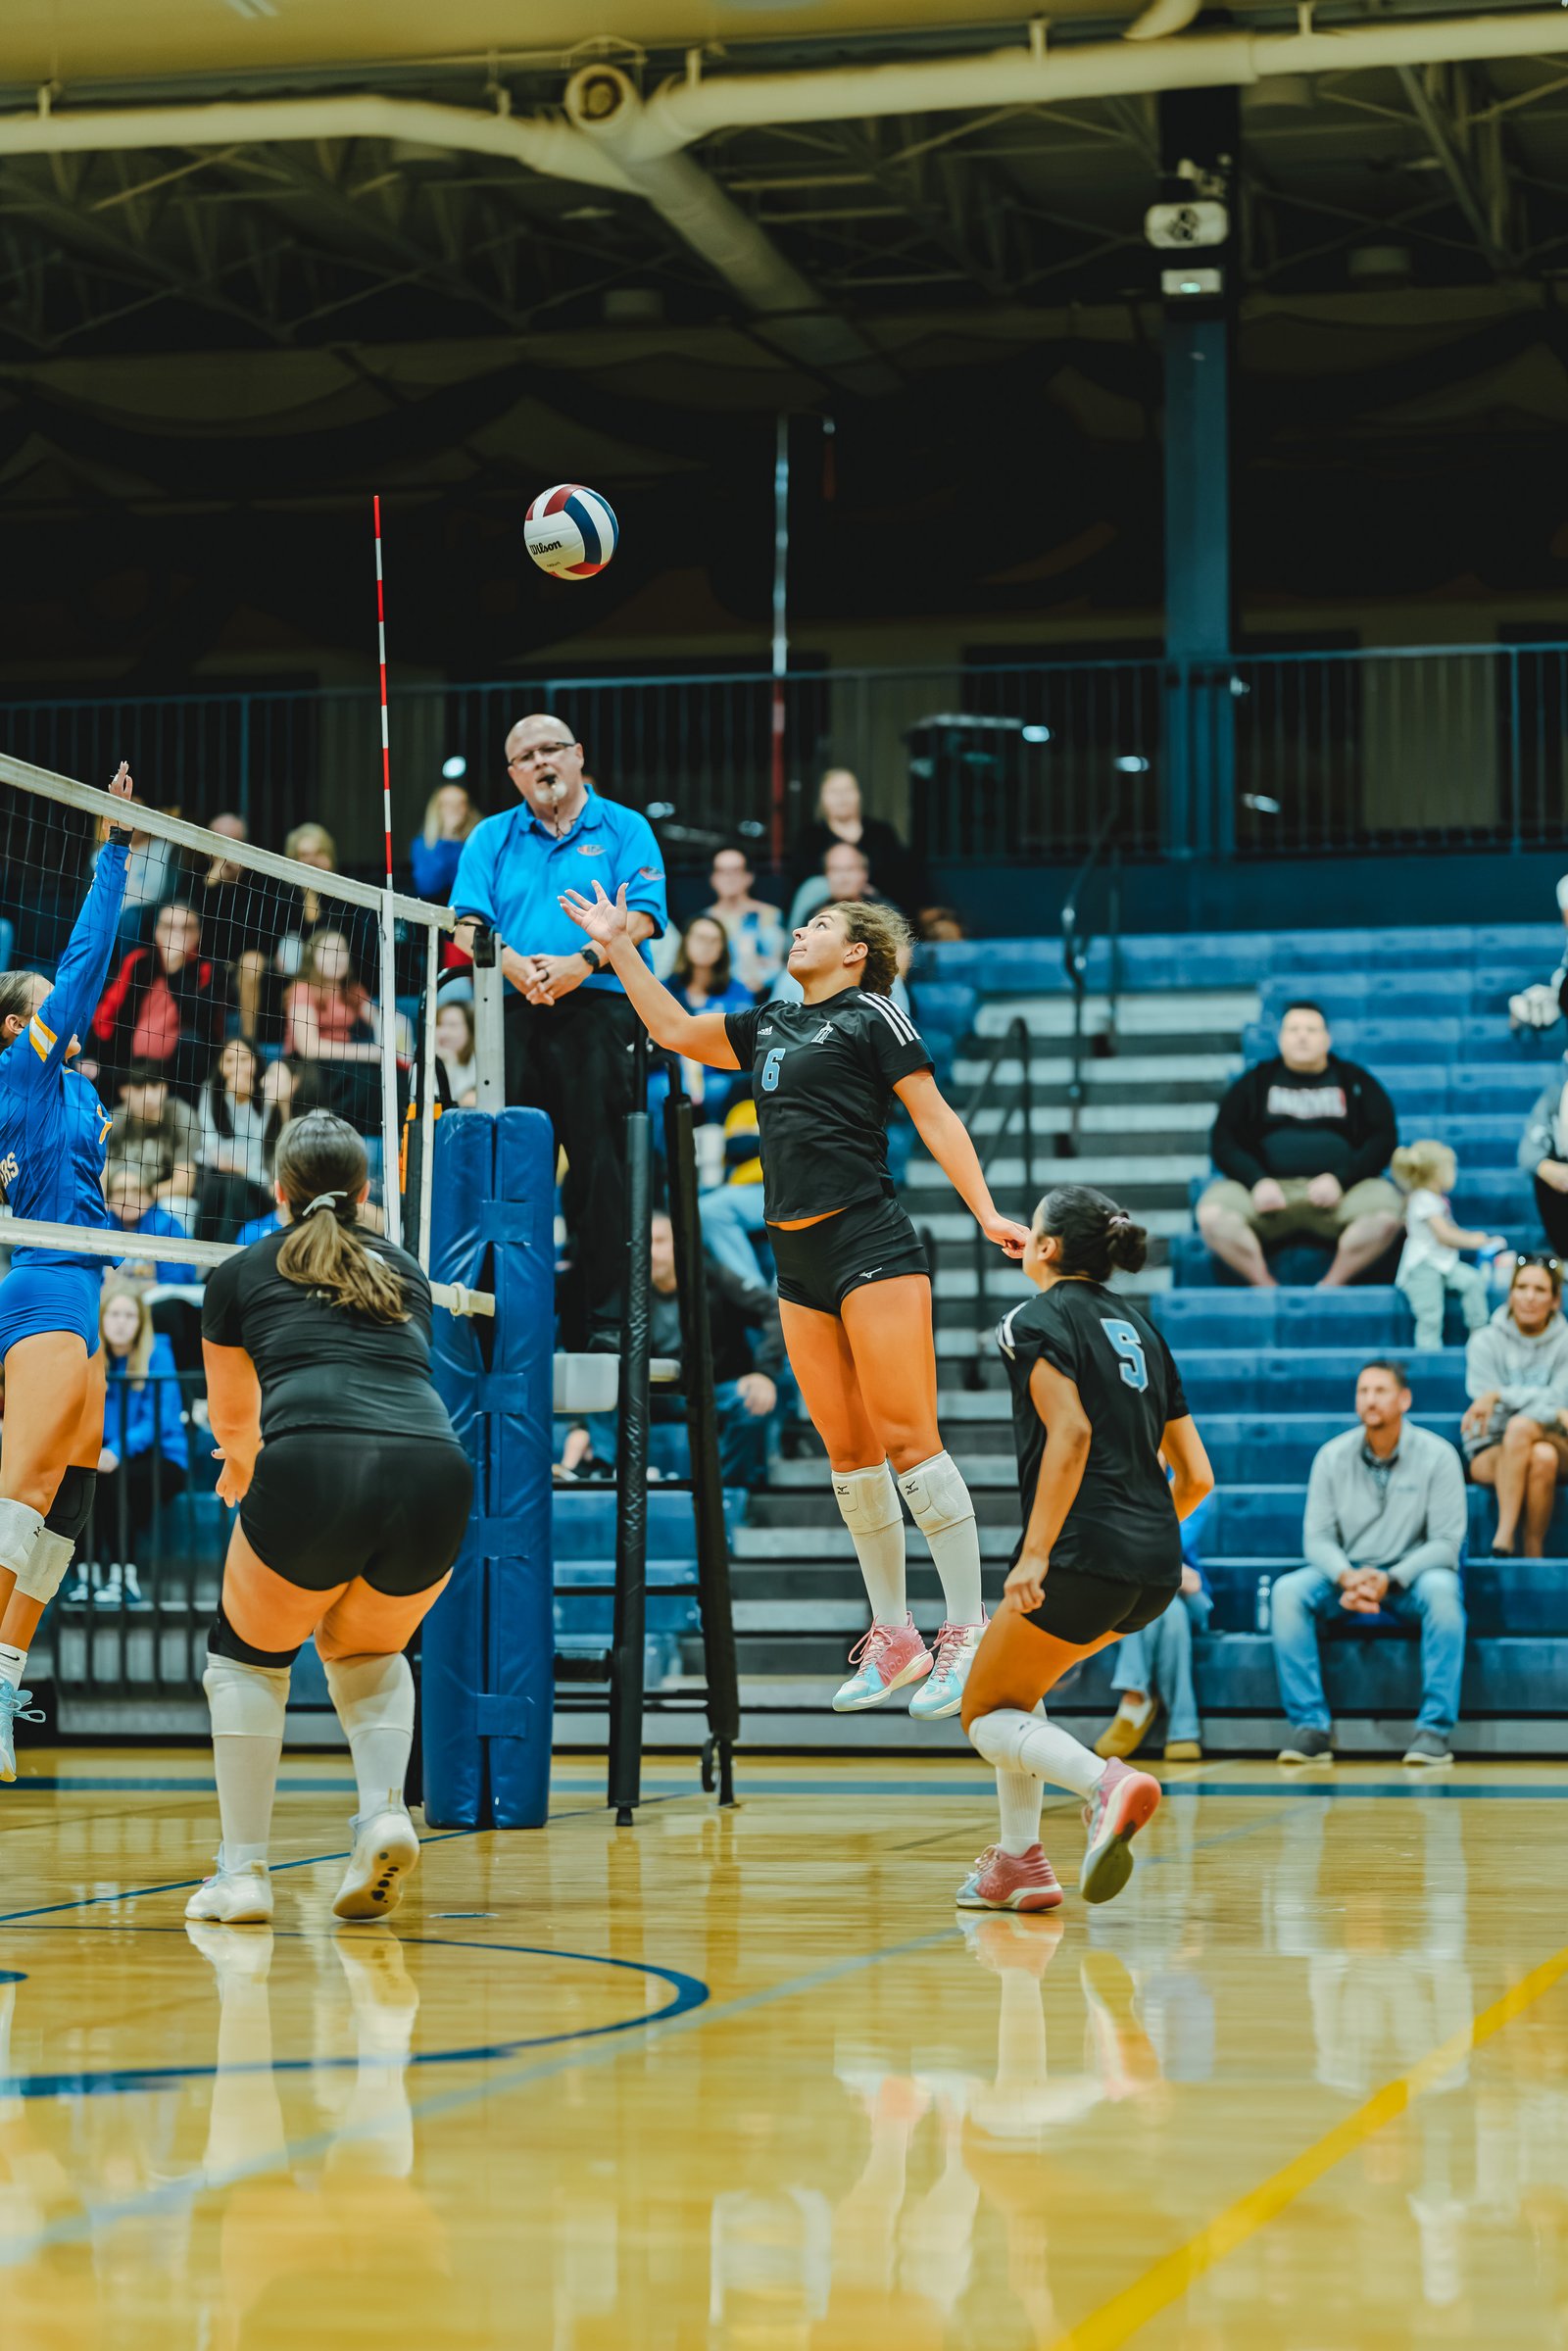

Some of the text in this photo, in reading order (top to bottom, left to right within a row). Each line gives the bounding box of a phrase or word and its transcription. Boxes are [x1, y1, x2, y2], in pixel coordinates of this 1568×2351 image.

[529, 540, 562, 555] Wilson
[761, 1048, 786, 1092] 6
[1100, 1317, 1149, 1393] 5
